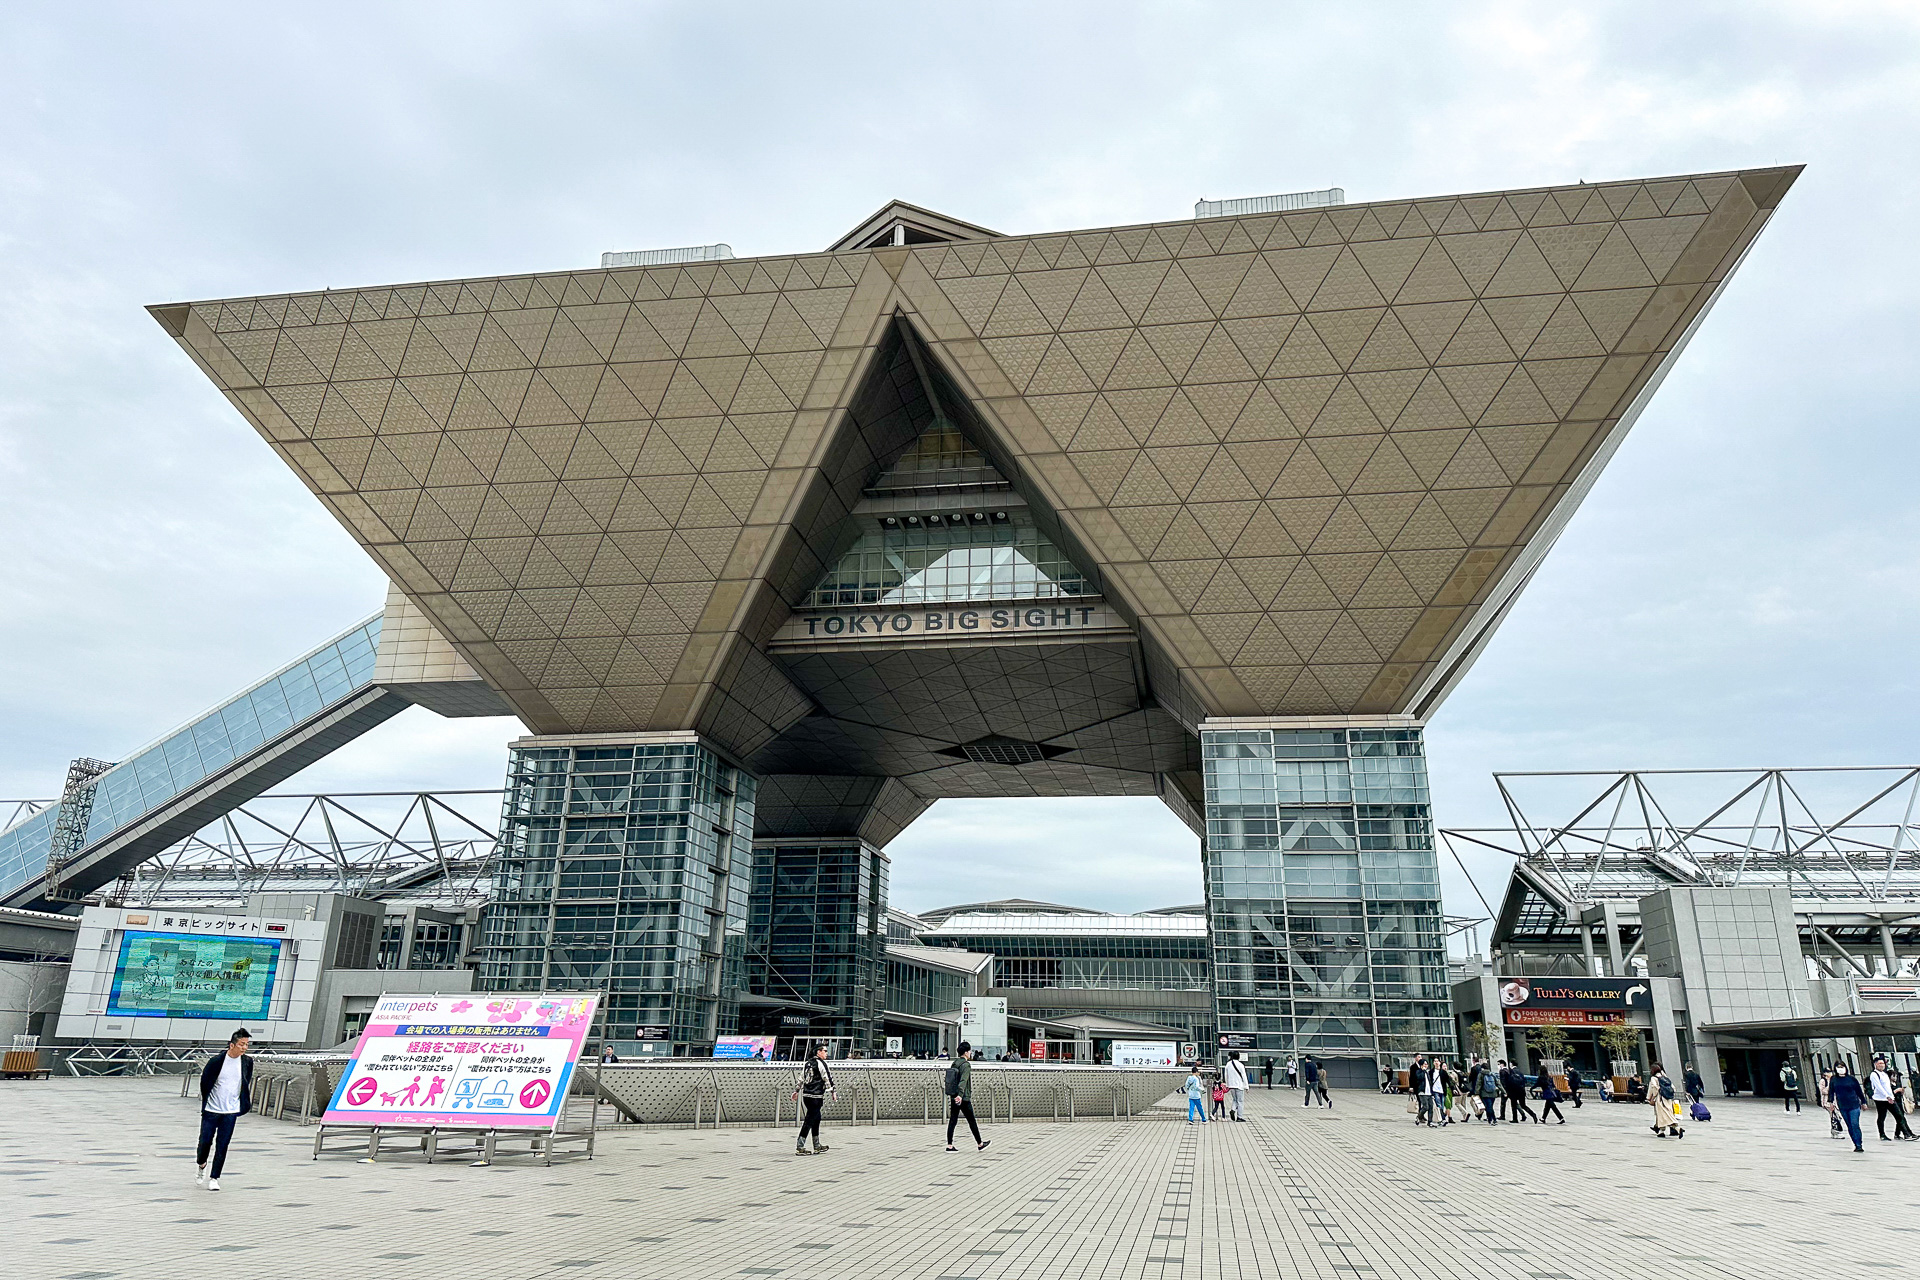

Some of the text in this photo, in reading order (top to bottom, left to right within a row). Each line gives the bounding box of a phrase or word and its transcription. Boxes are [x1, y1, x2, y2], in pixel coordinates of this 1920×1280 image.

[803, 607, 1095, 635] TOKYO BIG SIGHT
[163, 917, 259, 930] 東京ビッグサイト
[179, 959, 213, 967] あなたの
[177, 970, 249, 980] 大切な個人情報が
[175, 981, 234, 991] 狙われています
[1575, 990, 1621, 999] GALLERY
[380, 1000, 438, 1014] interpets
[783, 1016, 799, 1024] TOKYO
[405, 1025, 539, 1036] 会場での入場券の販売はありません
[406, 1041, 524, 1054] 経路をご確認ください
[381, 1054, 444, 1063] 同伴ペットの全身が
[480, 1055, 545, 1064] 同伴ペットの全身が
